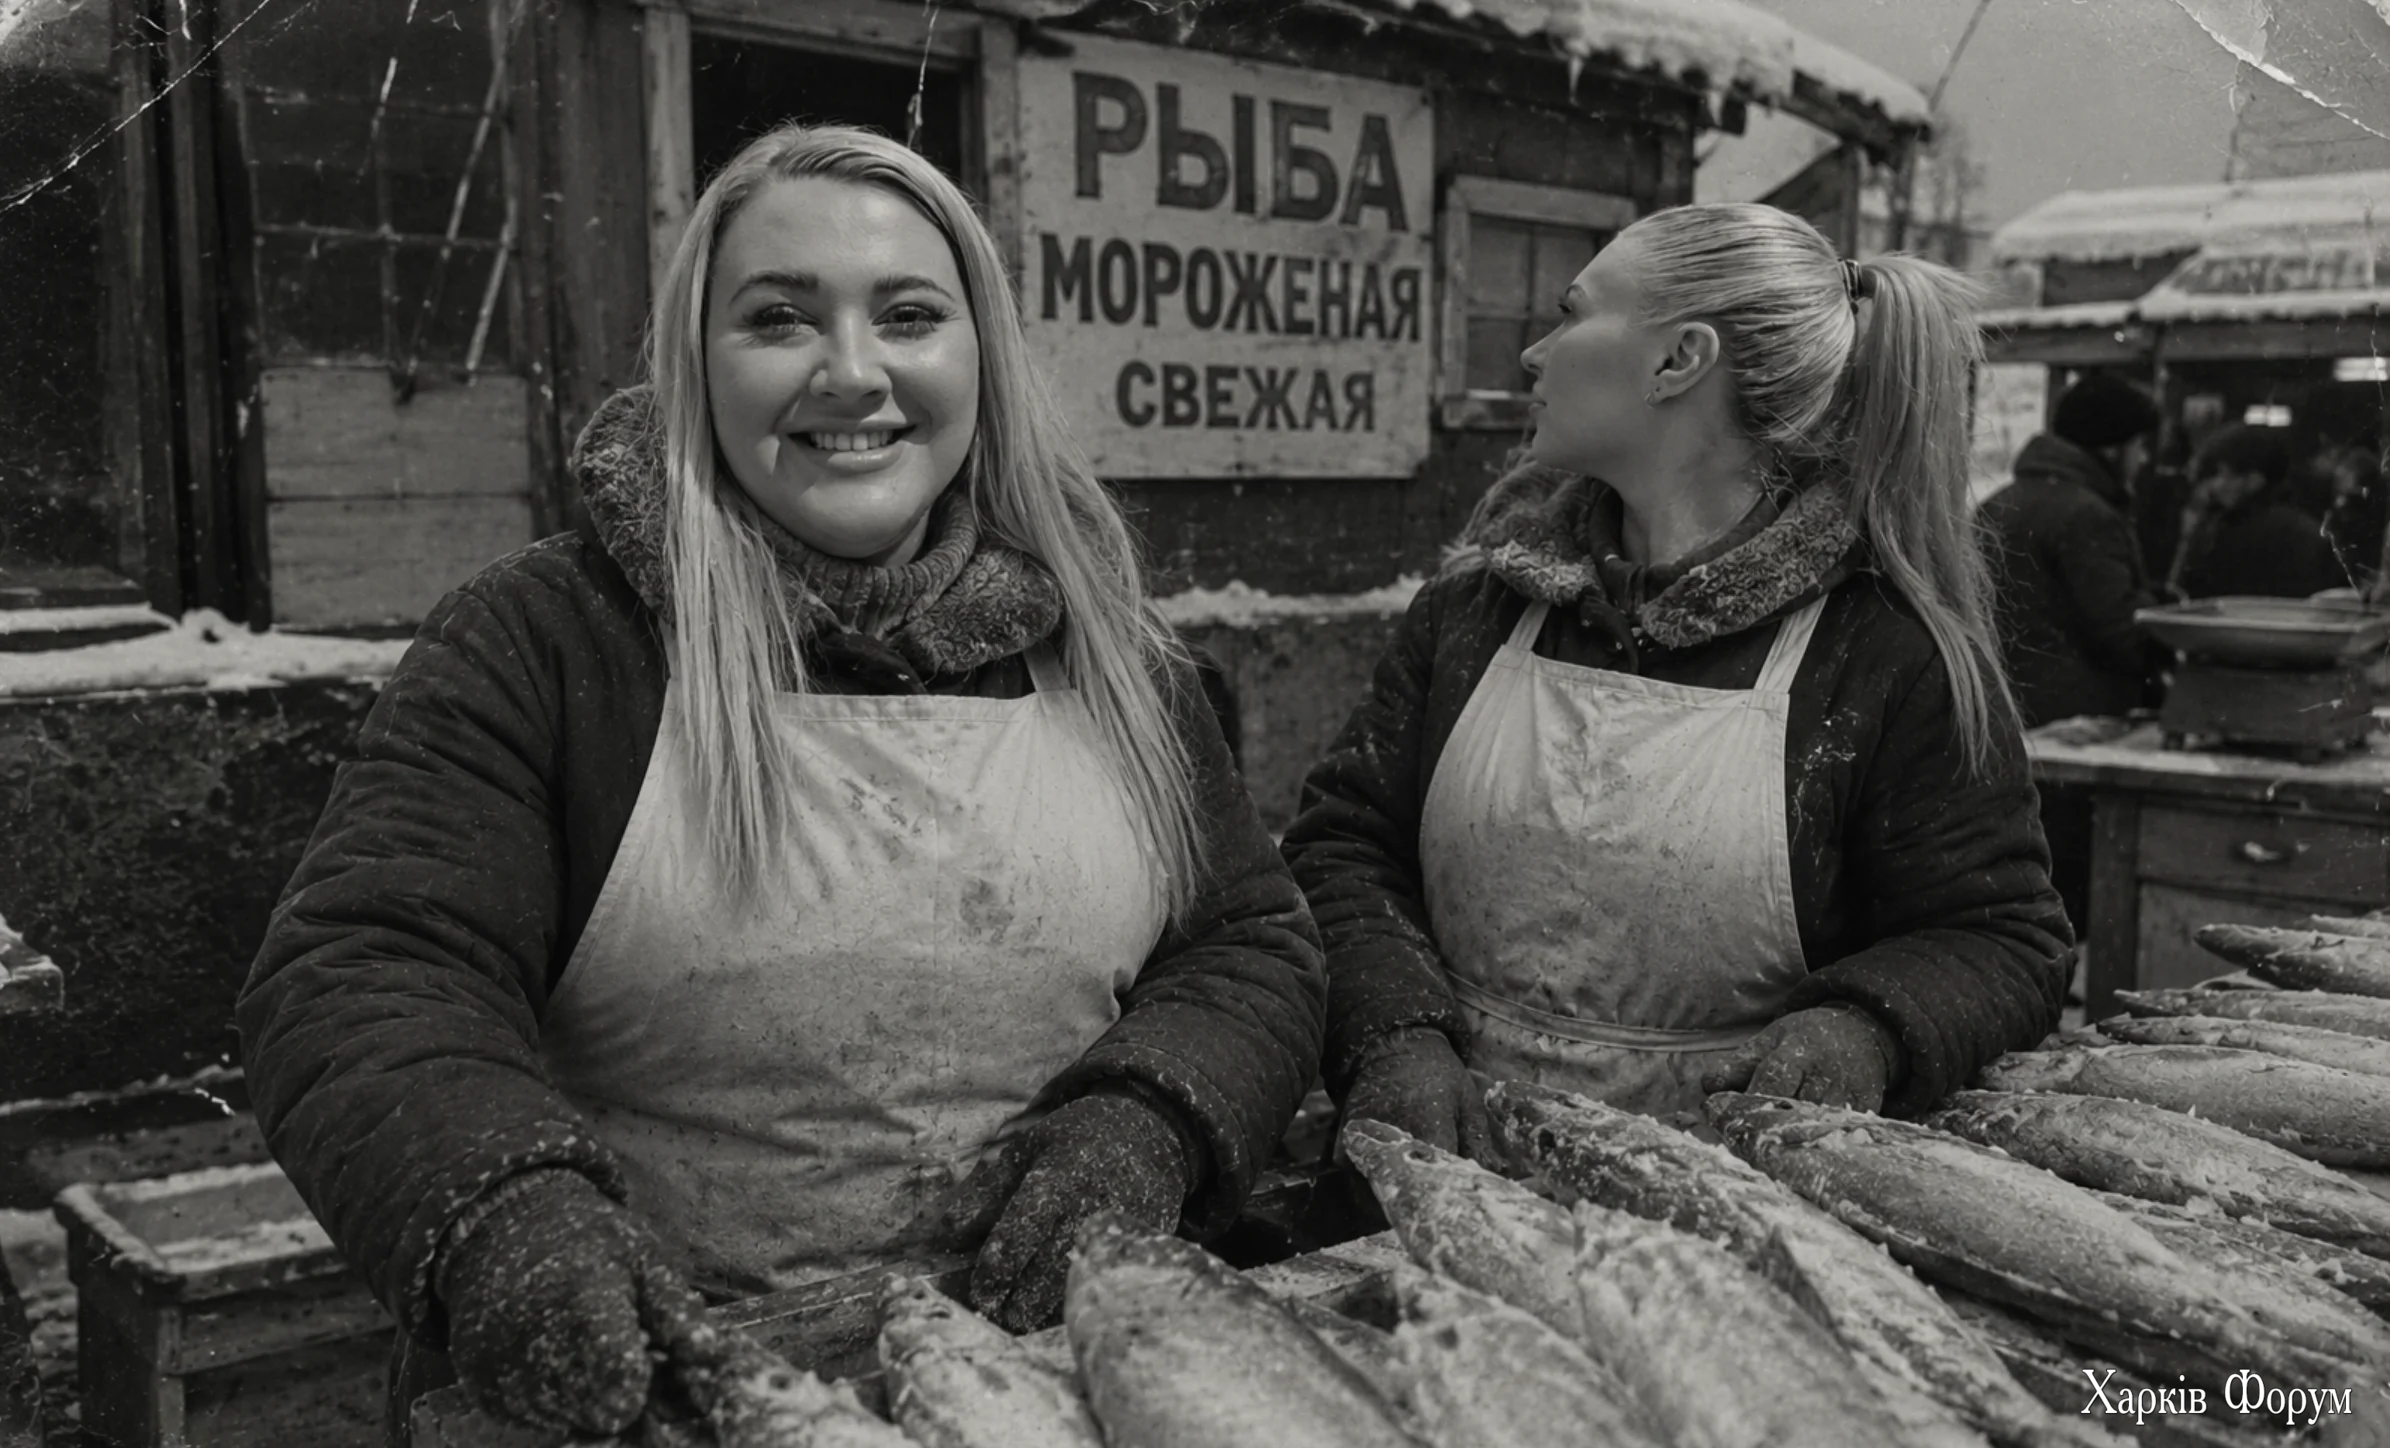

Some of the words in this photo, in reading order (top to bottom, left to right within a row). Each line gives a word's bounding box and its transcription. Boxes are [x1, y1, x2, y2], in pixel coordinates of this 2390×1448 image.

[1072, 70, 1409, 232] РЫБА
[1039, 233, 1421, 342] МОРОЖЕНАЯ
[1116, 359, 1376, 432] СВЕЖАЯ
